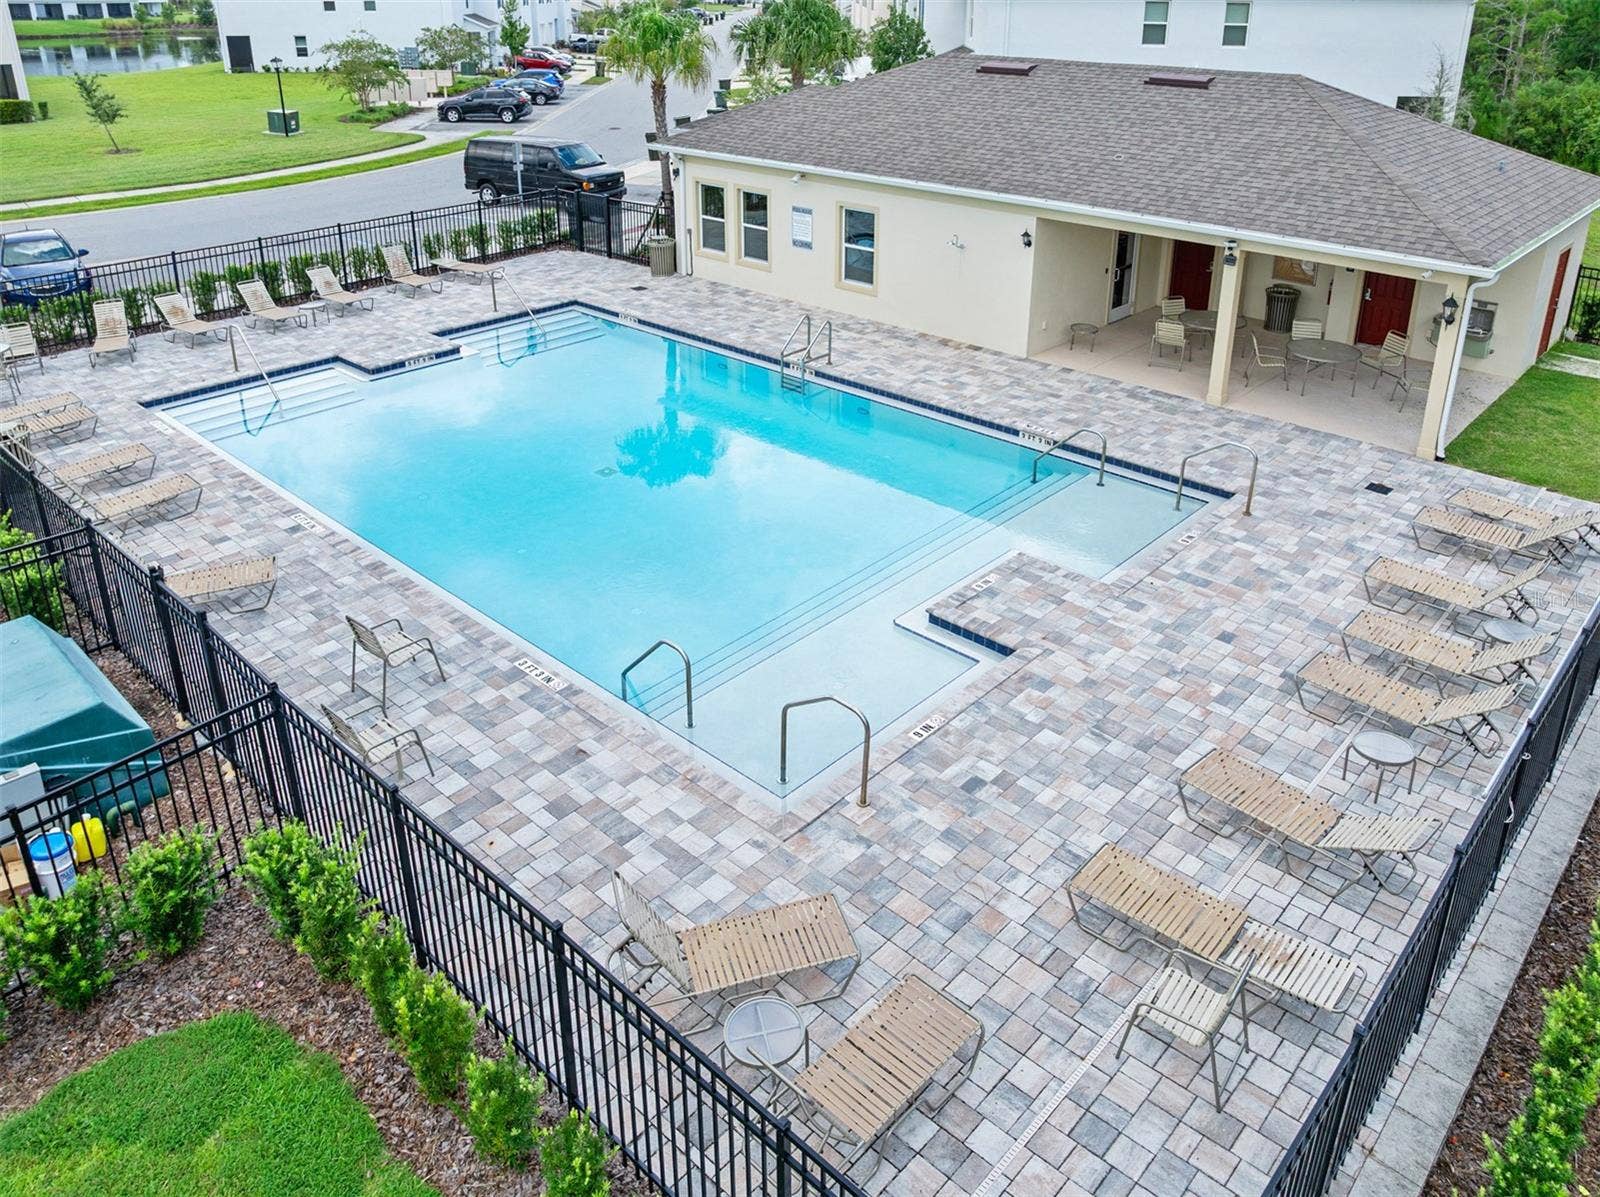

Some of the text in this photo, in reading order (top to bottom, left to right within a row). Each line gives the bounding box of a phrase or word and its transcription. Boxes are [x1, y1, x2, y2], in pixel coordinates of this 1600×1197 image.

[524, 664, 539, 673] FT
[541, 674, 555, 684] IN
[920, 723, 935, 733] IN
